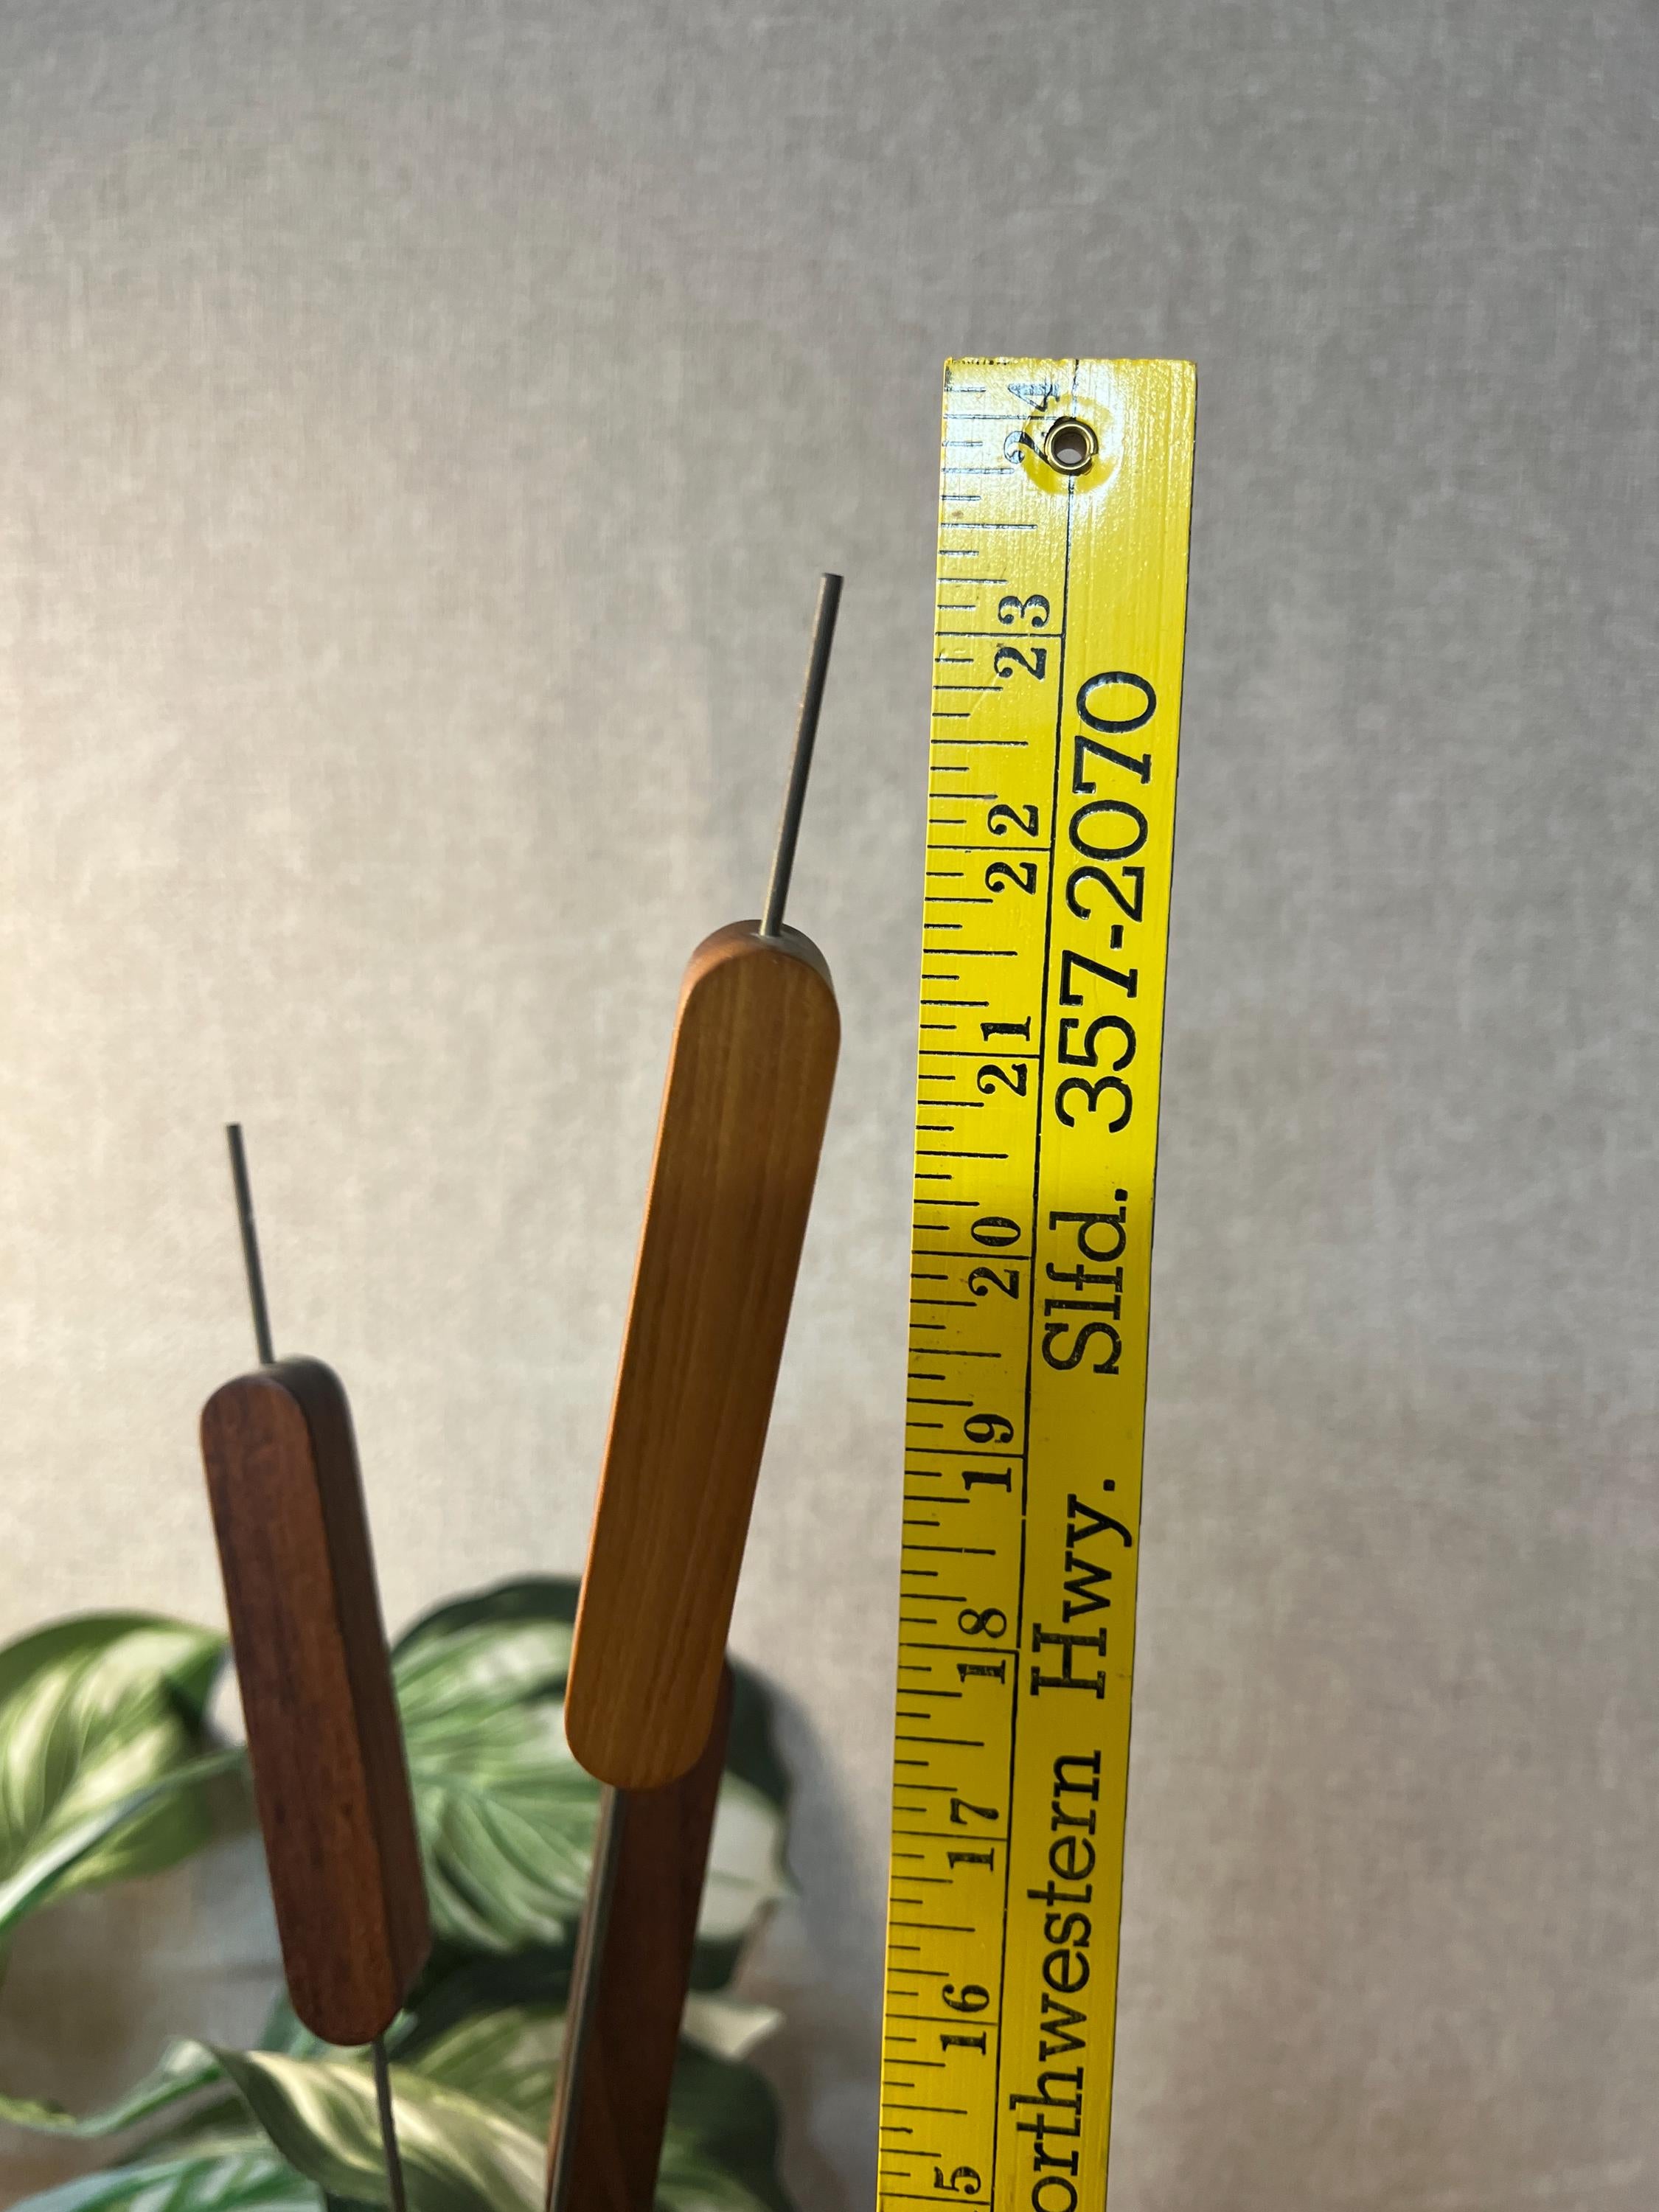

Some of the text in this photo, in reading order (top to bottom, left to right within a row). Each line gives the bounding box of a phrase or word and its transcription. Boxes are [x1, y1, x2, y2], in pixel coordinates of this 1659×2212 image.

[993, 594, 1050, 681] 23
[984, 804, 1039, 894] 22
[1054, 670, 1157, 1133] 357-2070
[976, 1015, 1032, 1097] 21
[967, 1215, 1021, 1299] 20
[1041, 1188, 1128, 1375] Slfd.
[961, 1413, 1015, 1493] 19
[1030, 1478, 1133, 1700] Hwy.
[956, 1607, 1007, 1684] 18
[947, 1797, 999, 1872] 17
[939, 1983, 990, 2056] 16
[933, 2166, 982, 2212] 5
